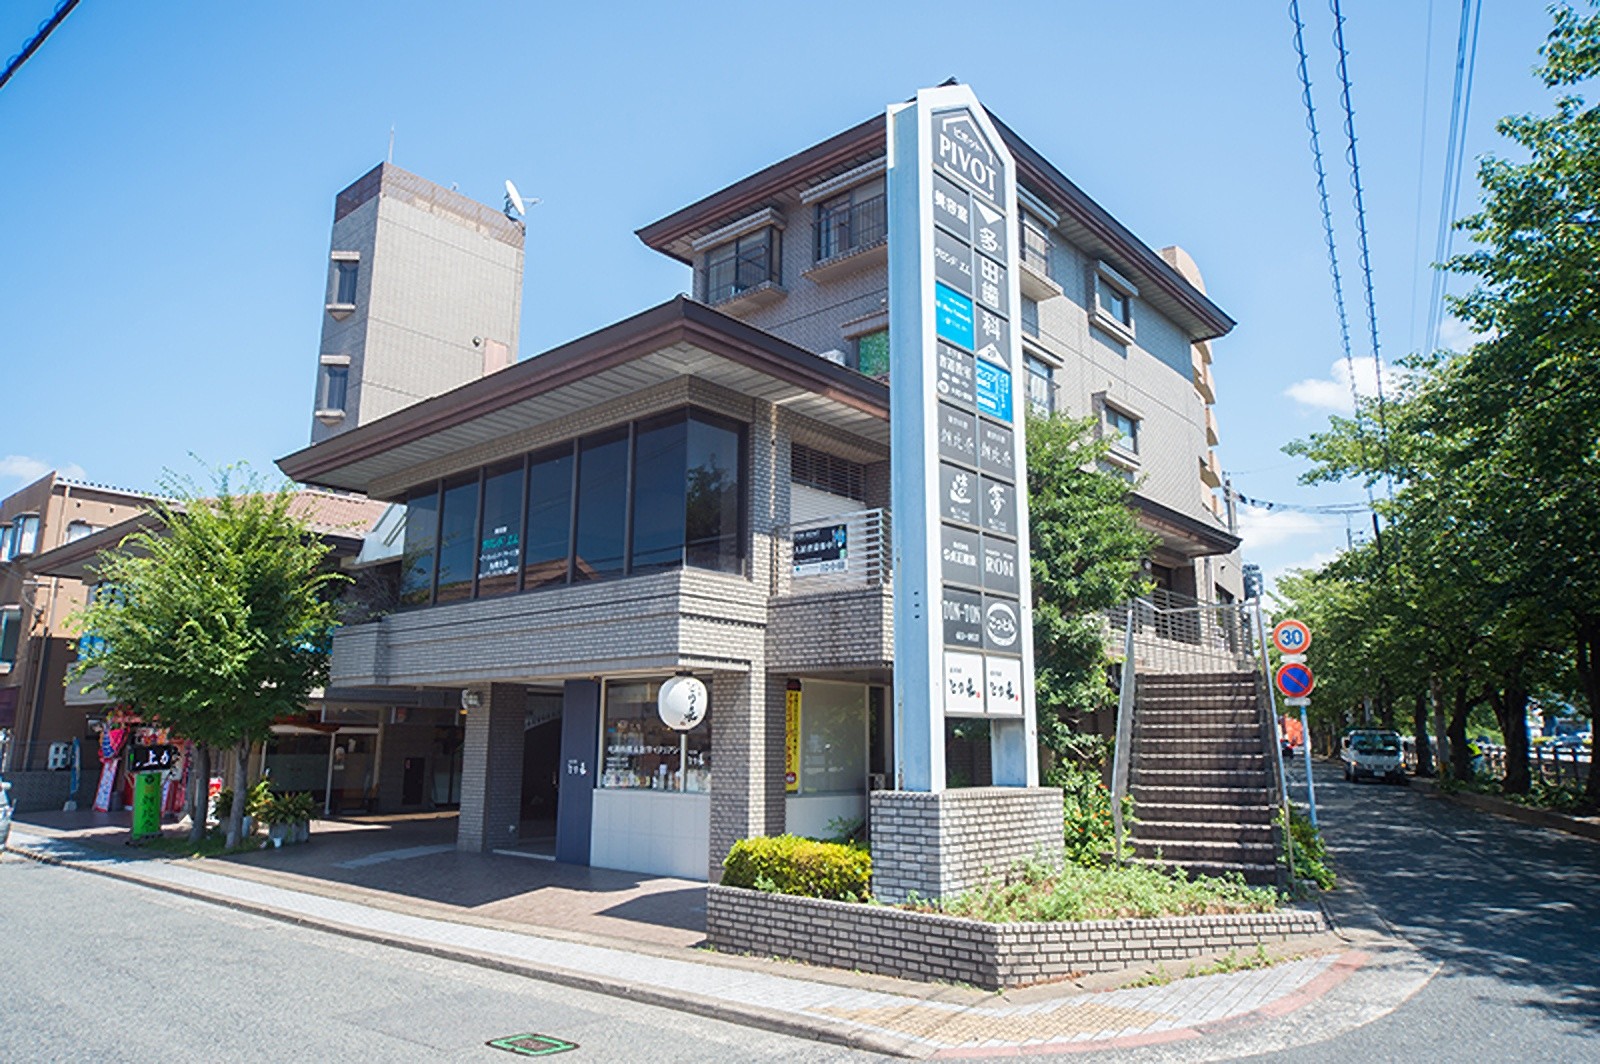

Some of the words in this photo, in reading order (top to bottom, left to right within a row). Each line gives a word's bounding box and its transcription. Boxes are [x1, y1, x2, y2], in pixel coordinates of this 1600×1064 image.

[939, 132, 997, 194] PIVOT
[935, 189, 969, 225] 美容室
[979, 227, 1001, 341] 多田歯科
[985, 555, 1014, 577] RON
[1281, 629, 1303, 646] 30
